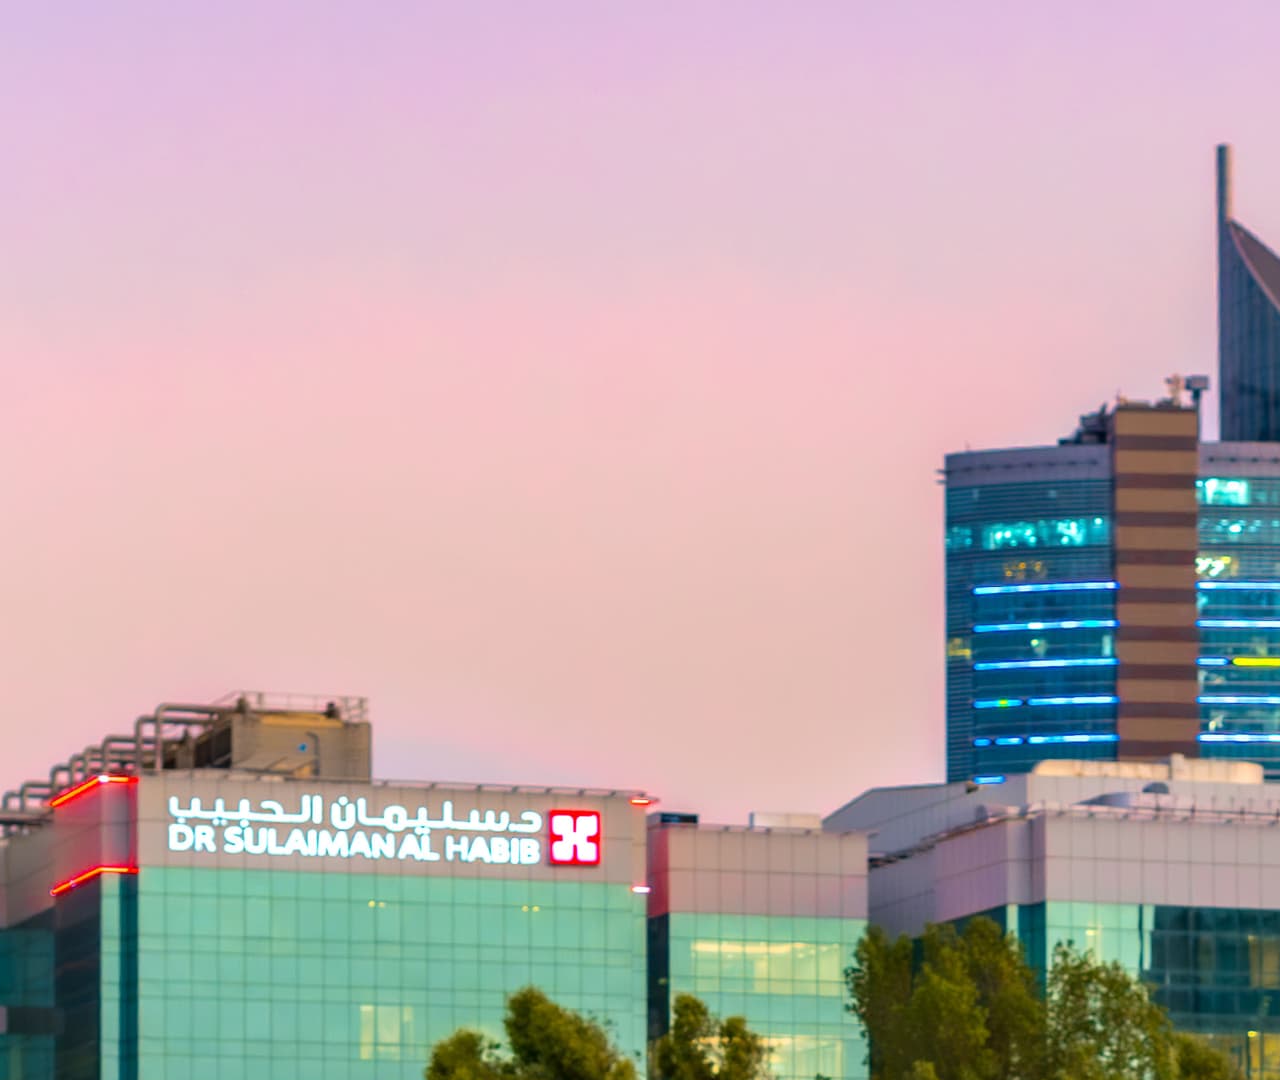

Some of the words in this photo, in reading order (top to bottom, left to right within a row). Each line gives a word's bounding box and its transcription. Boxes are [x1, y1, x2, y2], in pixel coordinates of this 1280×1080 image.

[169, 794, 323, 828] الحبيب
[168, 823, 217, 852] DR
[223, 826, 395, 859] SULAIMAN
[397, 832, 440, 861] AL
[445, 835, 541, 865] HABIB
